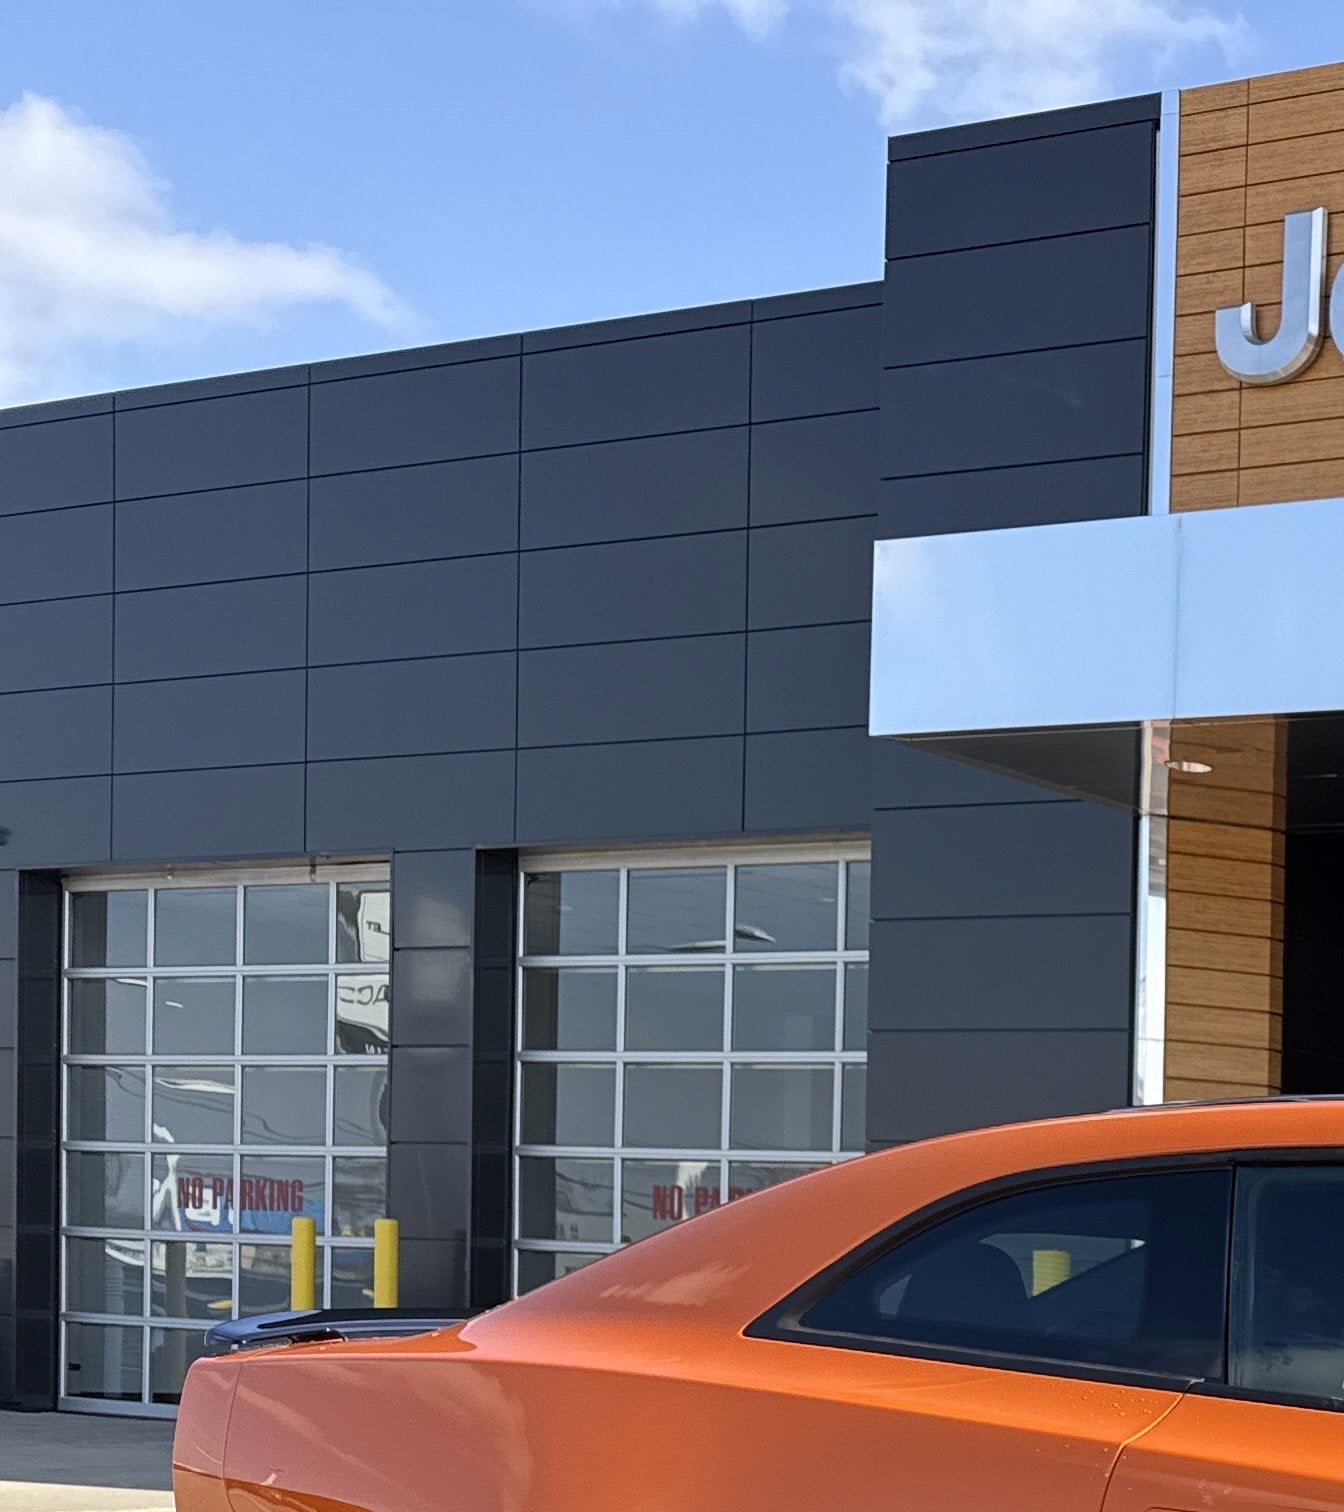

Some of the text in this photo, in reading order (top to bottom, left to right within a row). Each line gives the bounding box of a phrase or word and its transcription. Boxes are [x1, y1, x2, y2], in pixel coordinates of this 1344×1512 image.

[177, 1175, 305, 1213] NO PARKING
[652, 1184, 684, 1220] NO
